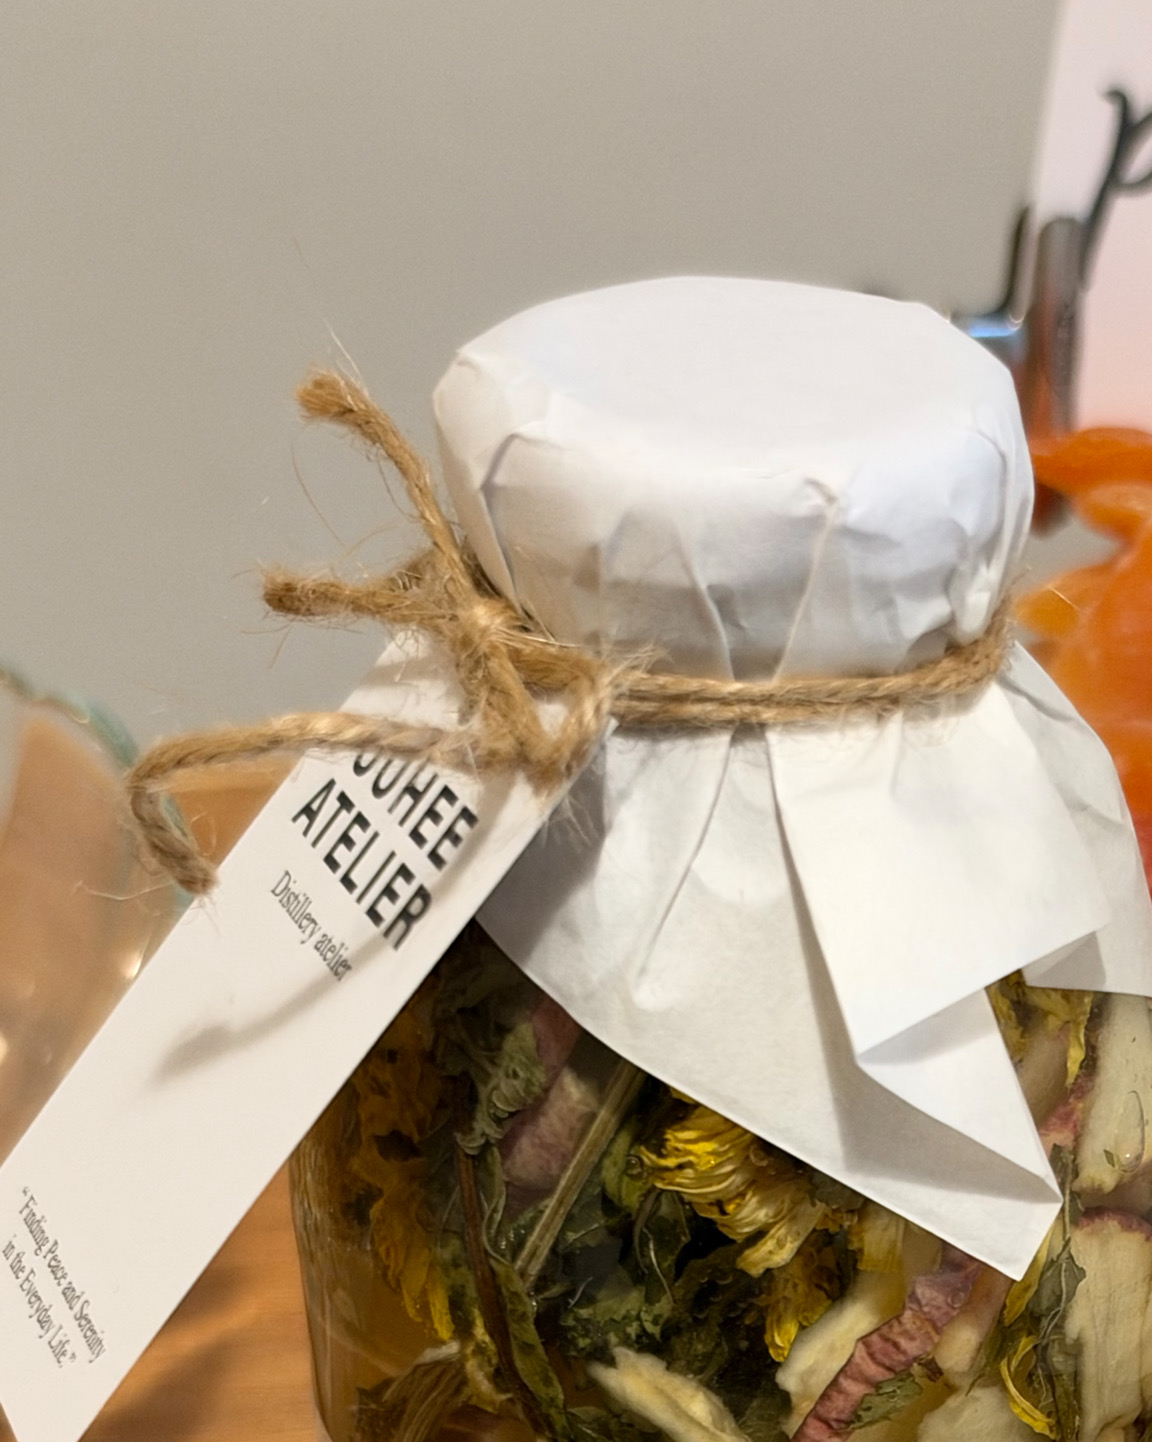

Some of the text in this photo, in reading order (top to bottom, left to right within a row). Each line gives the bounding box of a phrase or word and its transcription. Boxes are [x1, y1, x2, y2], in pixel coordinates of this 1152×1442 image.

[291, 777, 432, 952] ATELIER
[269, 868, 352, 981] Distillery atelier
[3, 1234, 17, 1260] in
[9, 1251, 26, 1279] the
[43, 1239, 68, 1287] Peace
[20, 1267, 56, 1339] Everyday
[61, 1281, 86, 1311] and
[73, 1299, 107, 1363] Serenity
